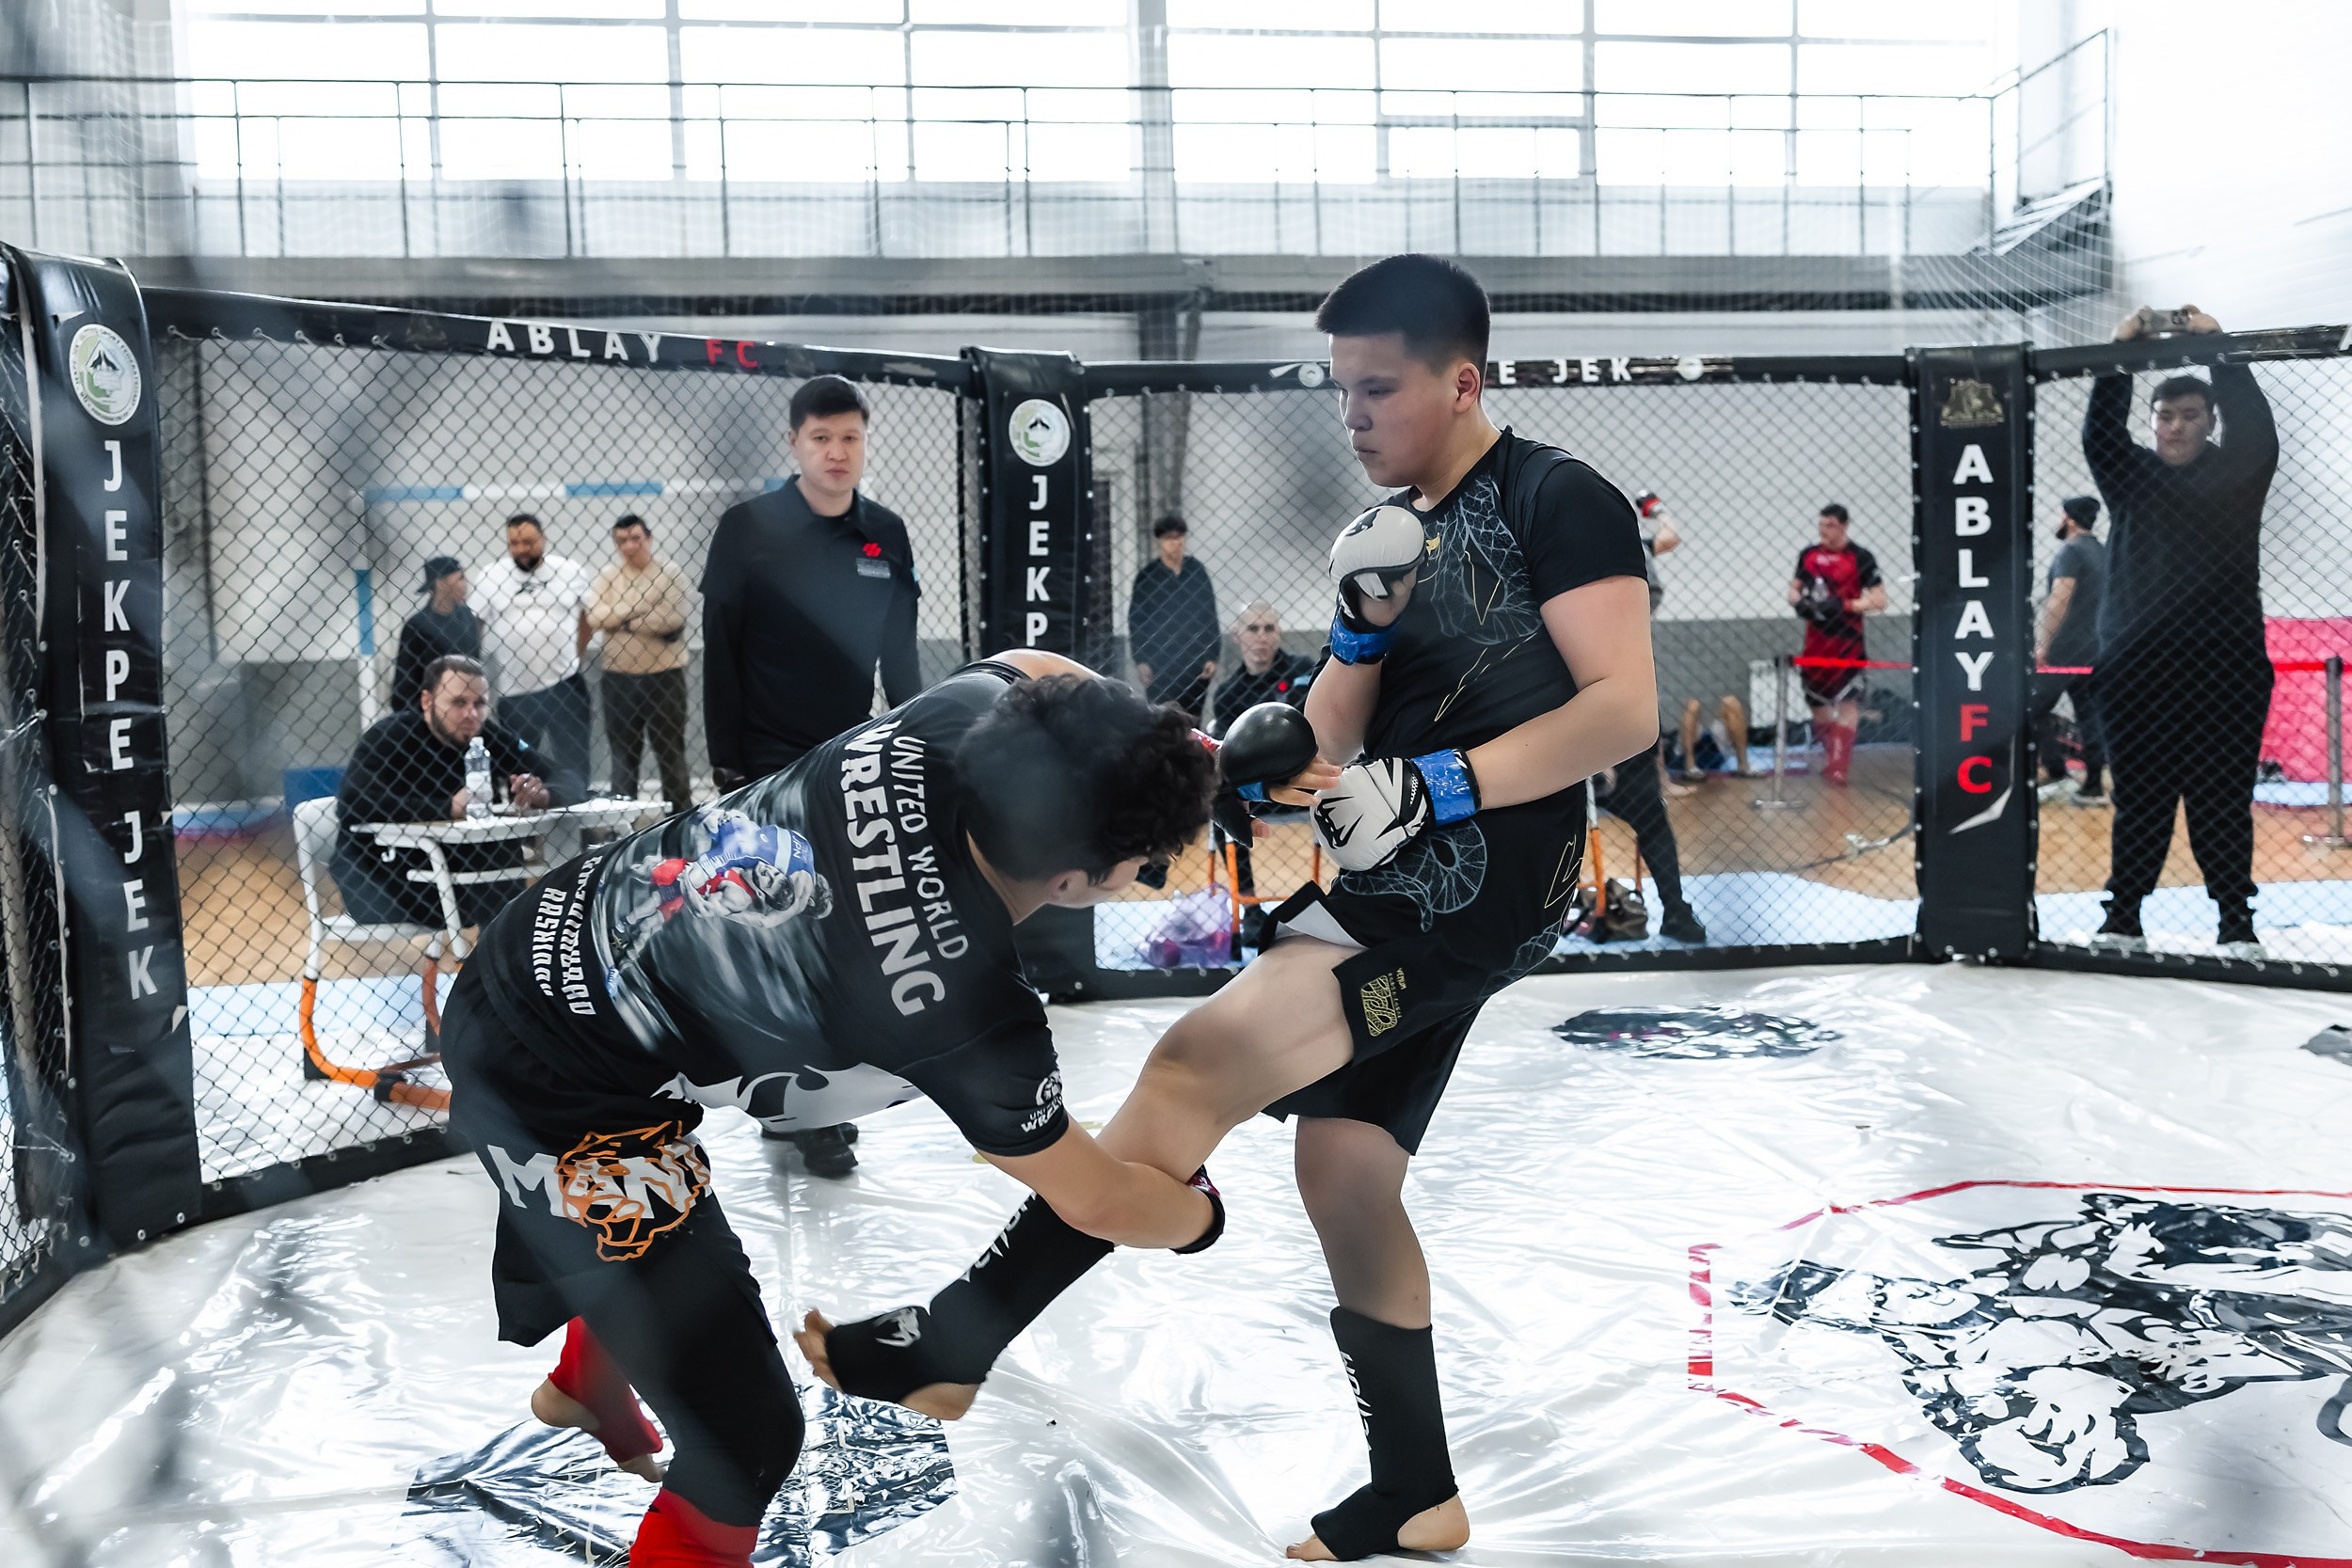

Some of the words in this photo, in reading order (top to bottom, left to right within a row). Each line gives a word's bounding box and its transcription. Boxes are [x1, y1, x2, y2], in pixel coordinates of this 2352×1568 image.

[487, 322, 661, 363] ABLAY
[705, 339, 758, 368] FC
[1025, 475, 1051, 647] JEKP
[1952, 444, 1994, 690] ABLAY
[103, 440, 134, 770] JEKPE
[123, 811, 157, 1000] JEK
[890, 736, 928, 833] UNITED
[1957, 704, 1993, 793] FC
[840, 720, 946, 1016] WRESTLING
[908, 846, 968, 959] WORLD
